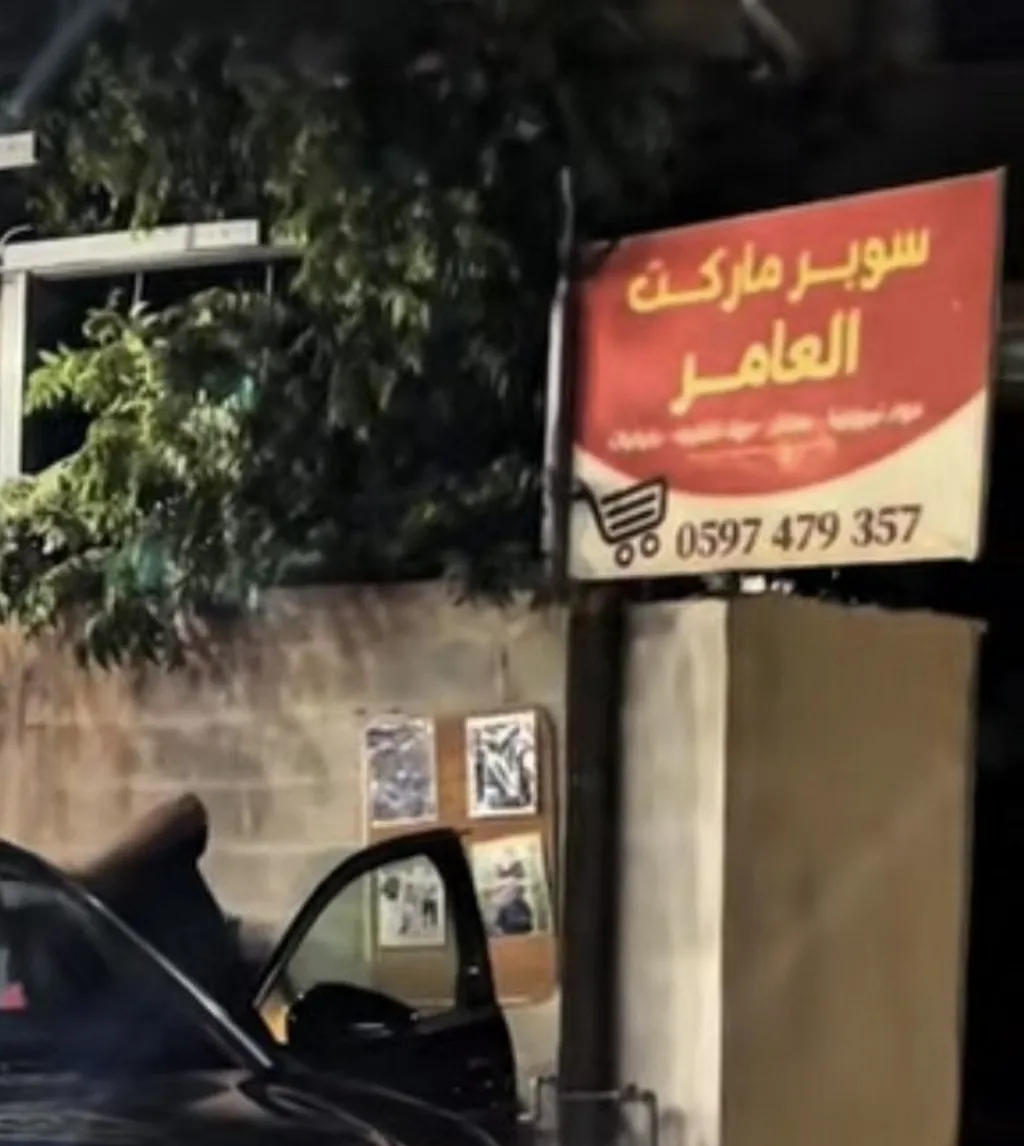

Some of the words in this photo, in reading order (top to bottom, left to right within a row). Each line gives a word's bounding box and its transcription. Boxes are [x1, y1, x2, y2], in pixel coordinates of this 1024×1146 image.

[627, 241, 783, 314] ماركت
[786, 227, 930, 304] سوبر
[669, 306, 862, 416] العامر
[675, 517, 763, 560] 0597
[771, 511, 840, 552] 479
[851, 503, 923, 547] 357
